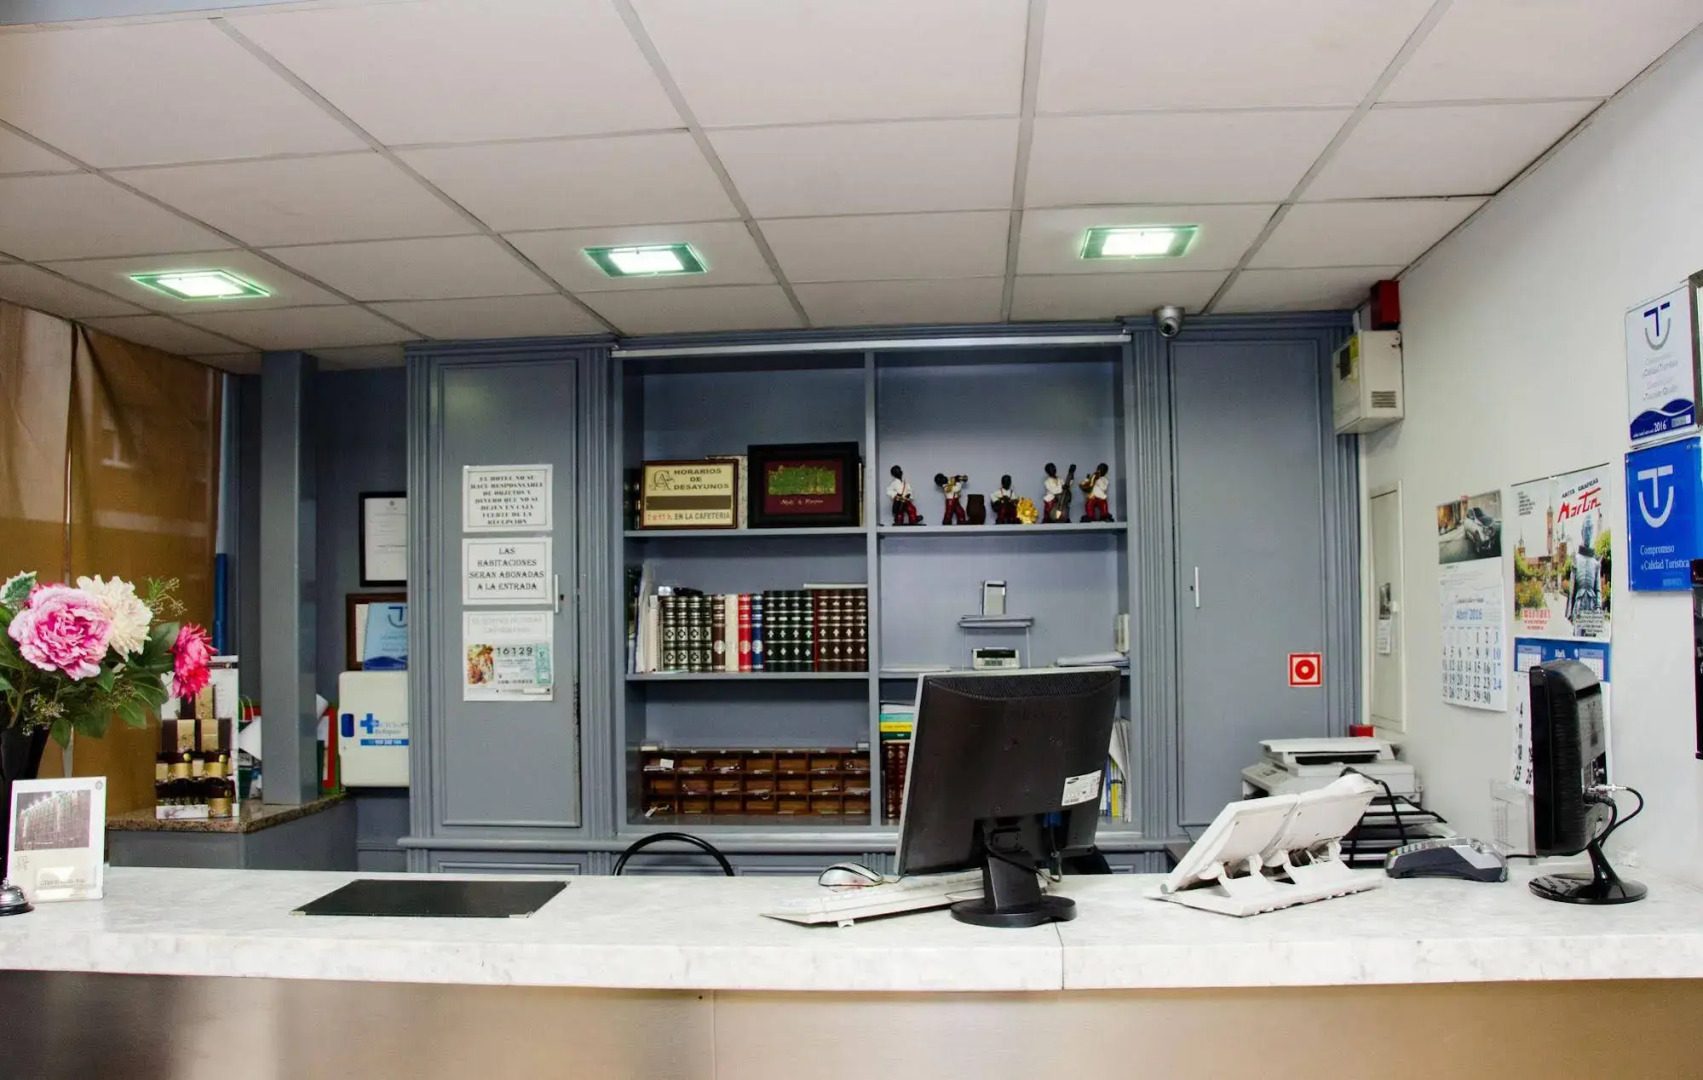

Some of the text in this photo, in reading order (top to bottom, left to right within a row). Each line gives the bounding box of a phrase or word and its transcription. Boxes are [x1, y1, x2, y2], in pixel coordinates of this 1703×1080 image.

[1640, 544, 1674, 556] Compromiso
[1644, 559, 1664, 570] Calidad
[496, 646, 532, 655] 16129
[1474, 661, 1480, 673] 15
[1484, 662, 1490, 674] 16
[1474, 676, 1480, 688] 22
[1484, 677, 1490, 689] 23
[1474, 690, 1480, 702] 29
[1483, 691, 1491, 704] 30
